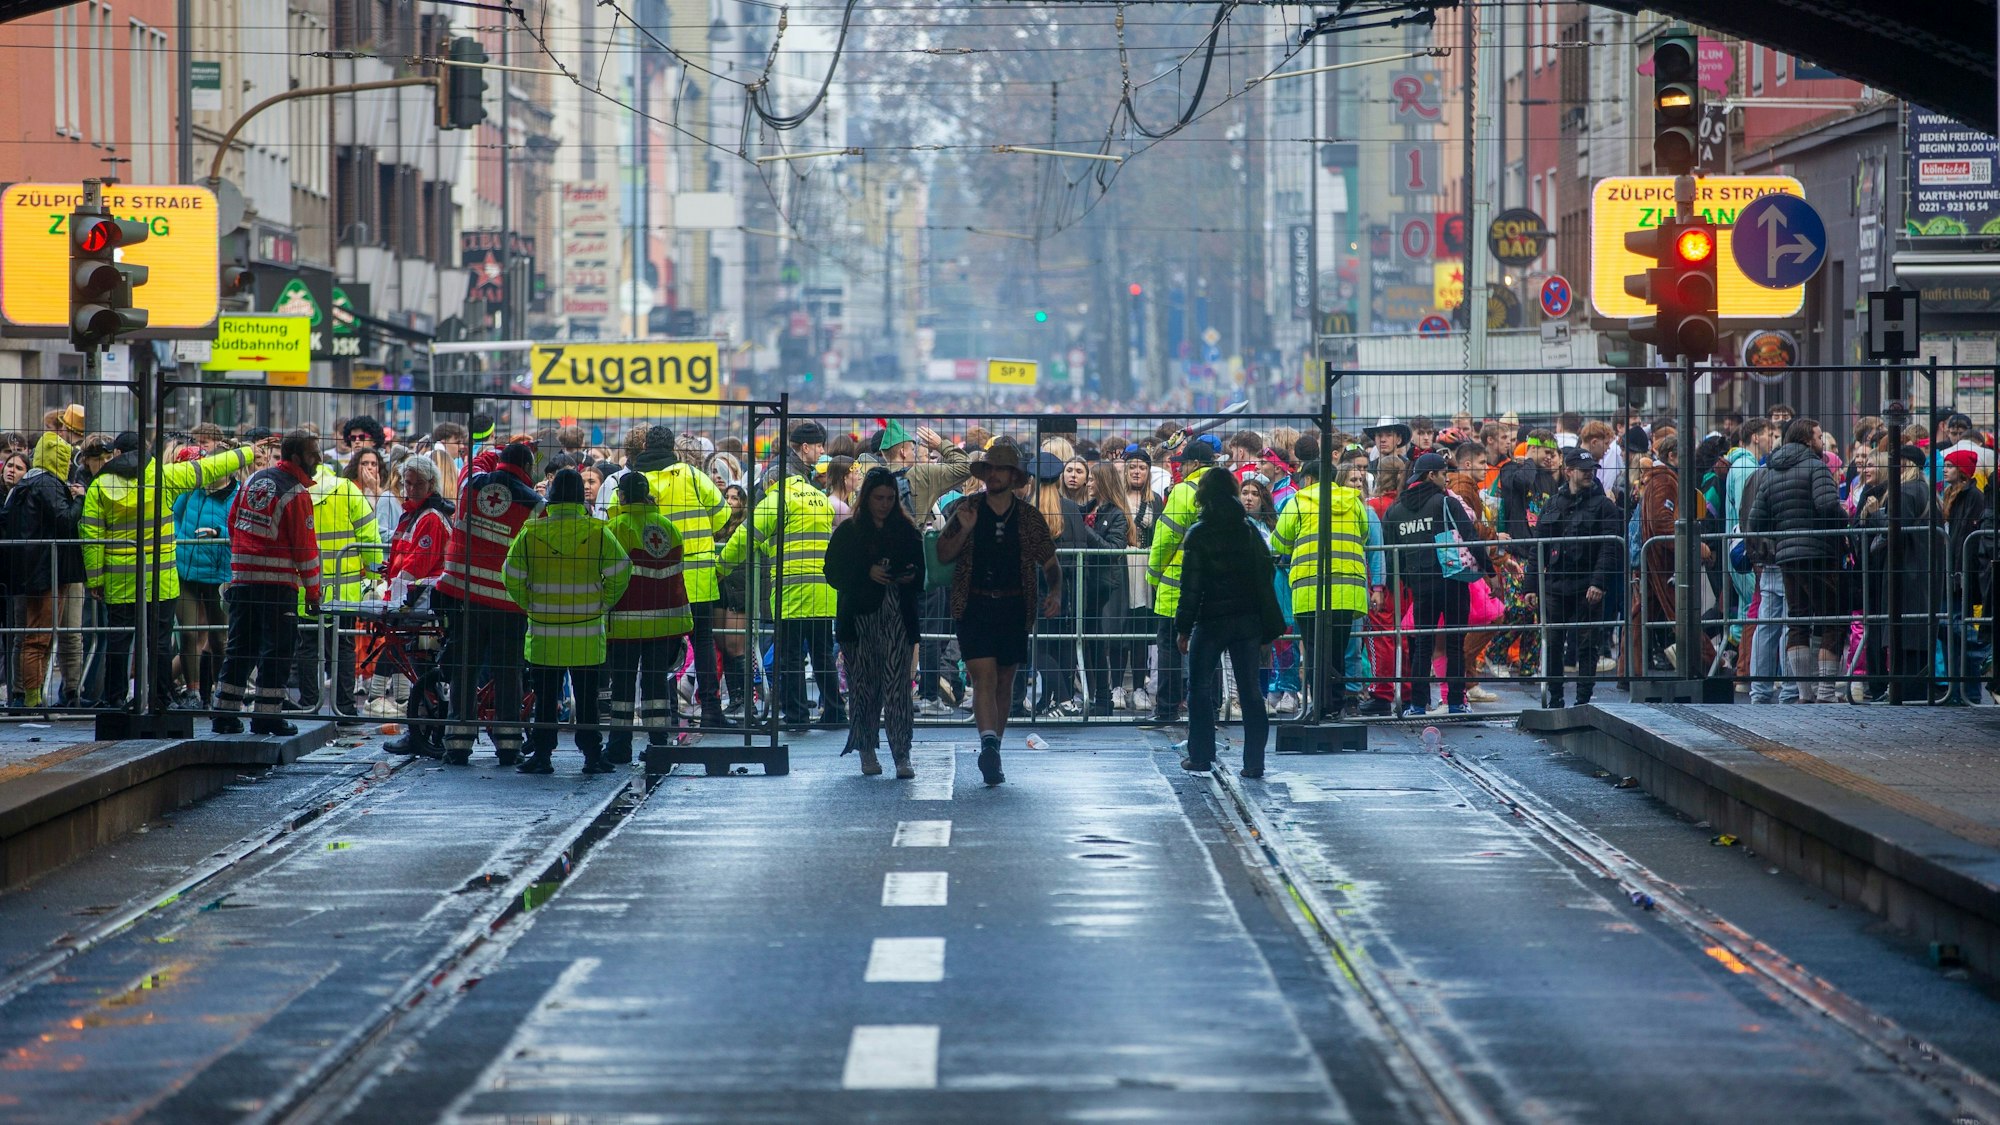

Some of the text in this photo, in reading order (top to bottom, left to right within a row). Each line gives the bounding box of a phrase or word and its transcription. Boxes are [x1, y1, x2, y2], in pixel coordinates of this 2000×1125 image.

[1918, 133, 1948, 142] JEDEN
[1949, 131, 1988, 141] FREITAG
[1918, 143, 1955, 153] BEGINN
[1956, 143, 1985, 152] 20.00
[1923, 162, 1968, 175] kölnticket
[1972, 166, 1989, 174] 0221
[16, 190, 124, 208] ZÜLPICER
[1918, 203, 1940, 212] 0221
[1947, 202, 1963, 211] 923
[1965, 202, 1976, 211] 16
[1977, 202, 1989, 211] 54
[1498, 239, 1538, 257] BAR
[223, 321, 288, 336] Richtung
[1871, 298, 1917, 351] H
[211, 338, 300, 351] Südbahnhof
[538, 347, 712, 394] Zugang
[1000, 366, 1026, 377] SP 9
[1399, 517, 1433, 536] SWAT
